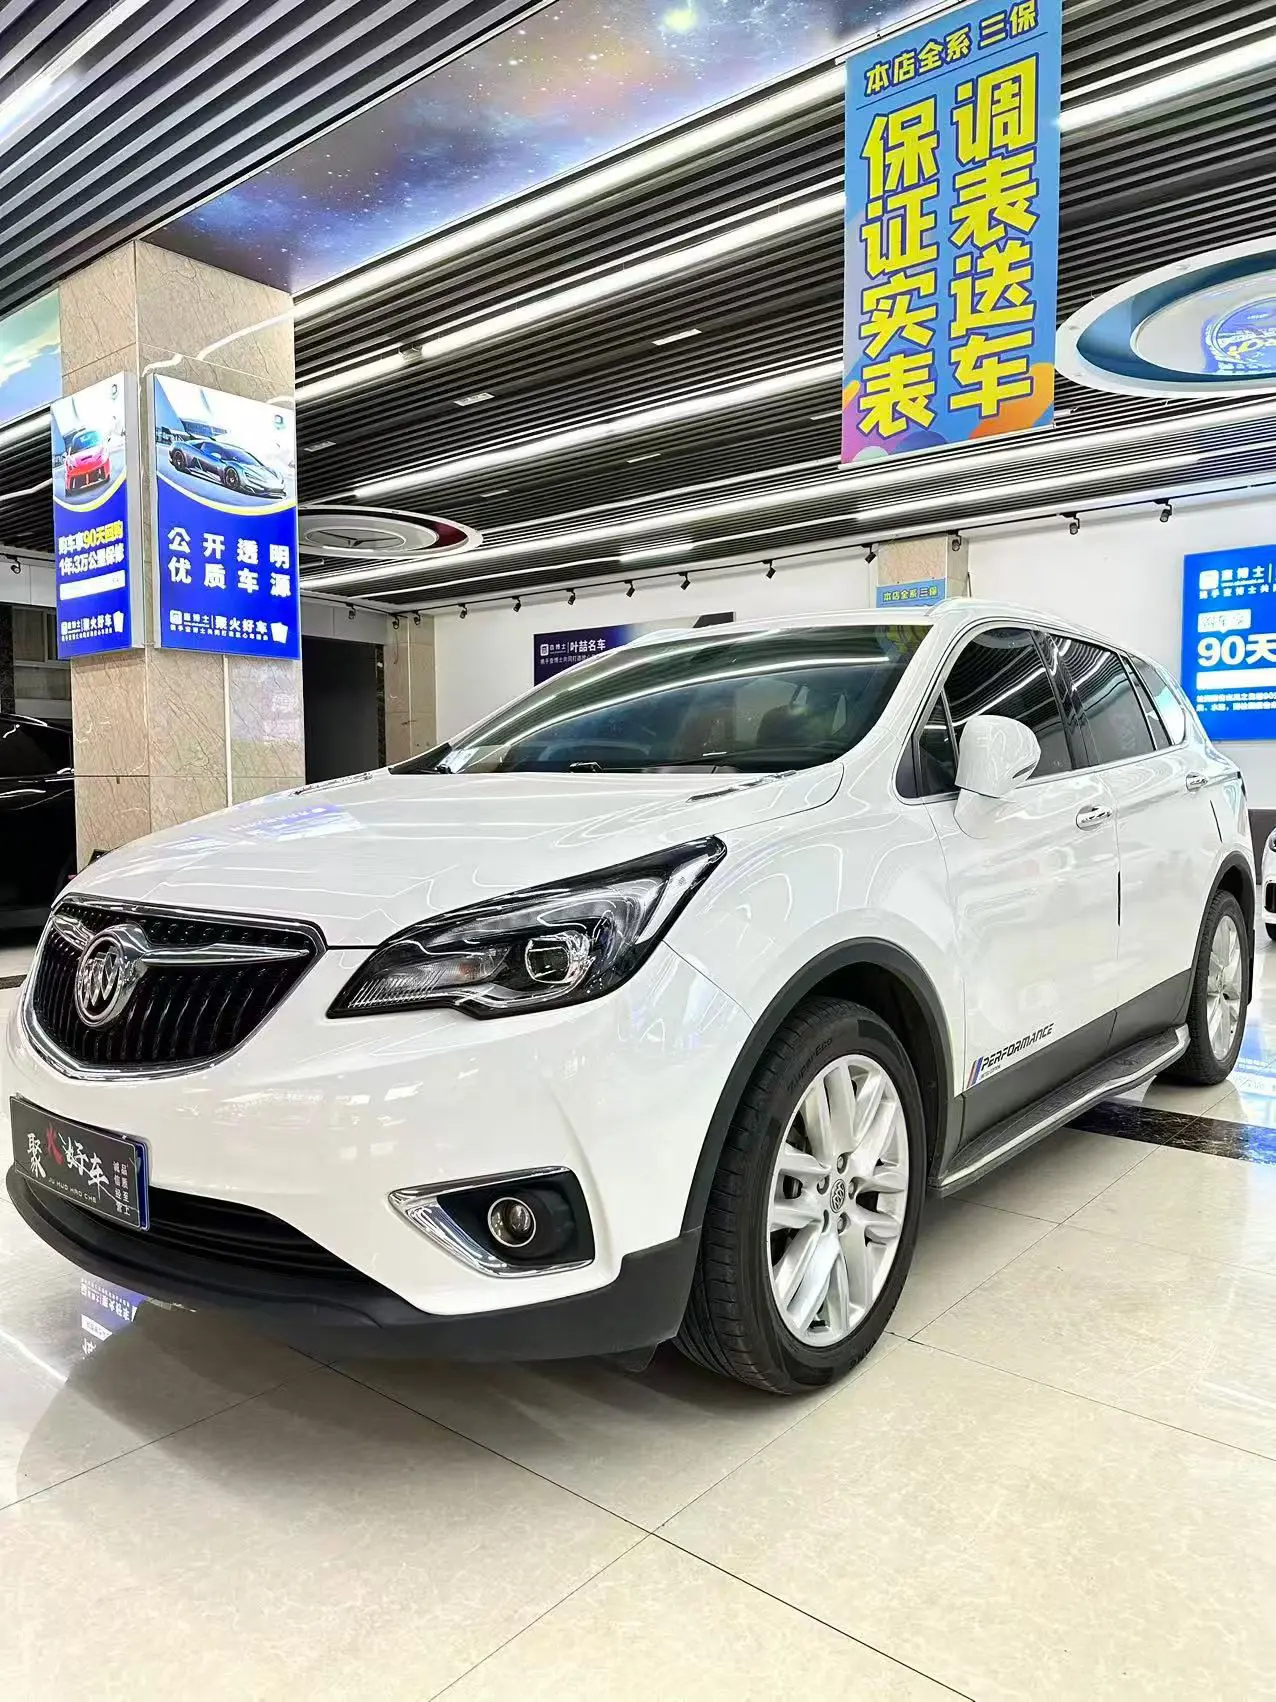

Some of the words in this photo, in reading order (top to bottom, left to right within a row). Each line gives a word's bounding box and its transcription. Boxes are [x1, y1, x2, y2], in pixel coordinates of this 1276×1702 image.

[864, 23, 972, 96] 本店全系
[978, 0, 1039, 48] 三保
[950, 53, 1039, 418] 调表送车
[858, 95, 940, 438] 保证实表
[167, 527, 290, 569] 公开透明
[168, 556, 292, 597] 优质车源
[883, 589, 917, 602] 本店全系
[570, 638, 606, 653] 叶喆名车
[1197, 632, 1276, 668] 90天
[981, 1022, 1055, 1072] PERFORMANCE
